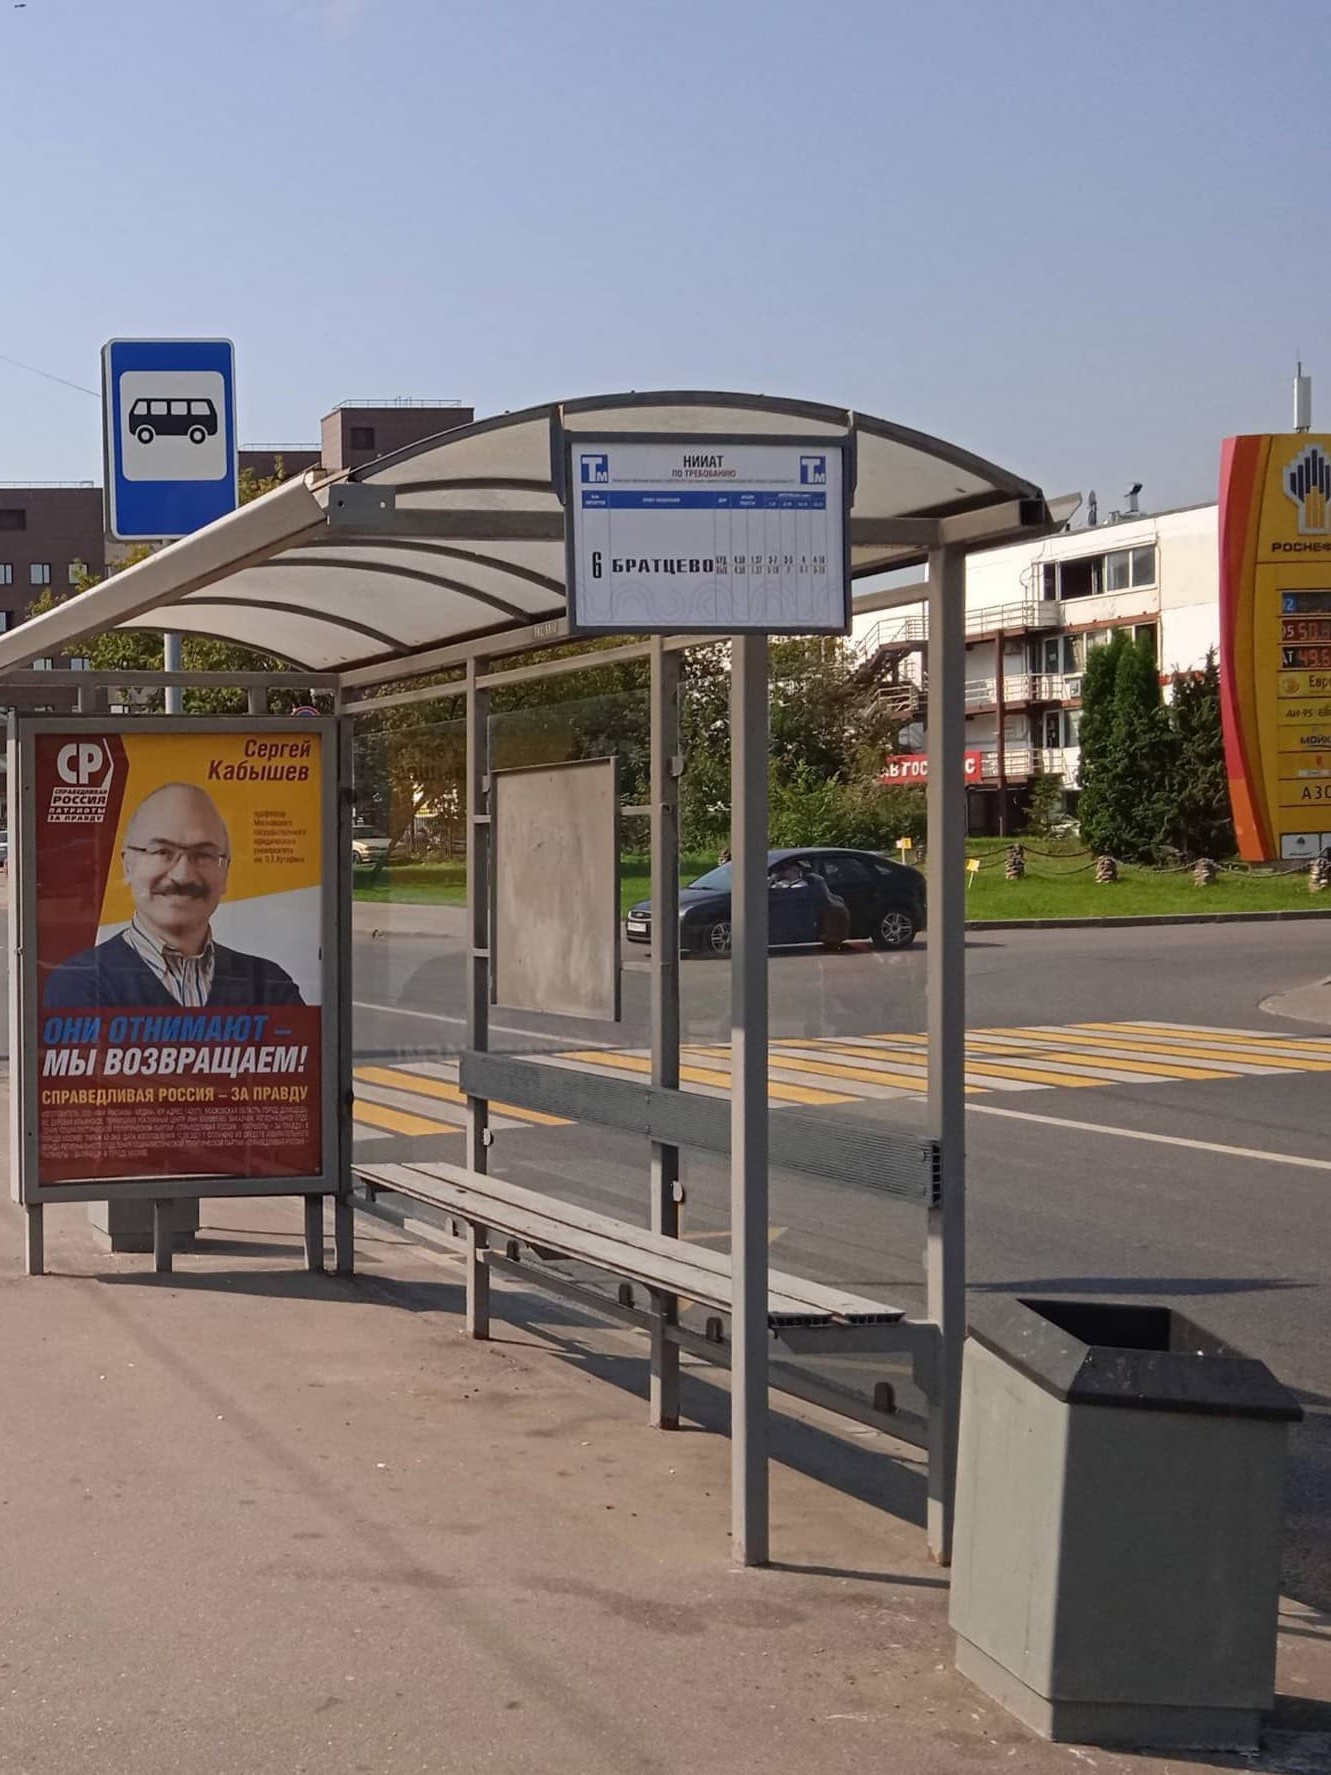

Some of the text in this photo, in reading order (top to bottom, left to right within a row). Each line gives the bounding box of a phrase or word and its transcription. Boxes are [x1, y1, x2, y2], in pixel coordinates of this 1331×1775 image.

[683, 455, 724, 468] НИИАТ
[672, 469, 737, 478] ПО ТРЕБОВАНИЮ
[592, 551, 602, 579] 6
[611, 558, 714, 575] БРАТЦЕВО
[1282, 598, 1294, 612] 2
[244, 738, 312, 763] Сергей
[57, 743, 103, 784] СР
[207, 759, 310, 782] Кабышев
[52, 796, 107, 805] РОССИЯ
[43, 1016, 101, 1044] ОНИ
[108, 1014, 268, 1043] ОТНИМАЮТ
[42, 1045, 309, 1079] МЫ ВОЗВРАЩАЕМ!
[42, 1088, 154, 1106] СПРАВЕДЛИВАЯ
[158, 1087, 215, 1102] РОССИЯ
[231, 1086, 249, 1101] ЗА
[254, 1085, 309, 1103] ПРАВДУ
